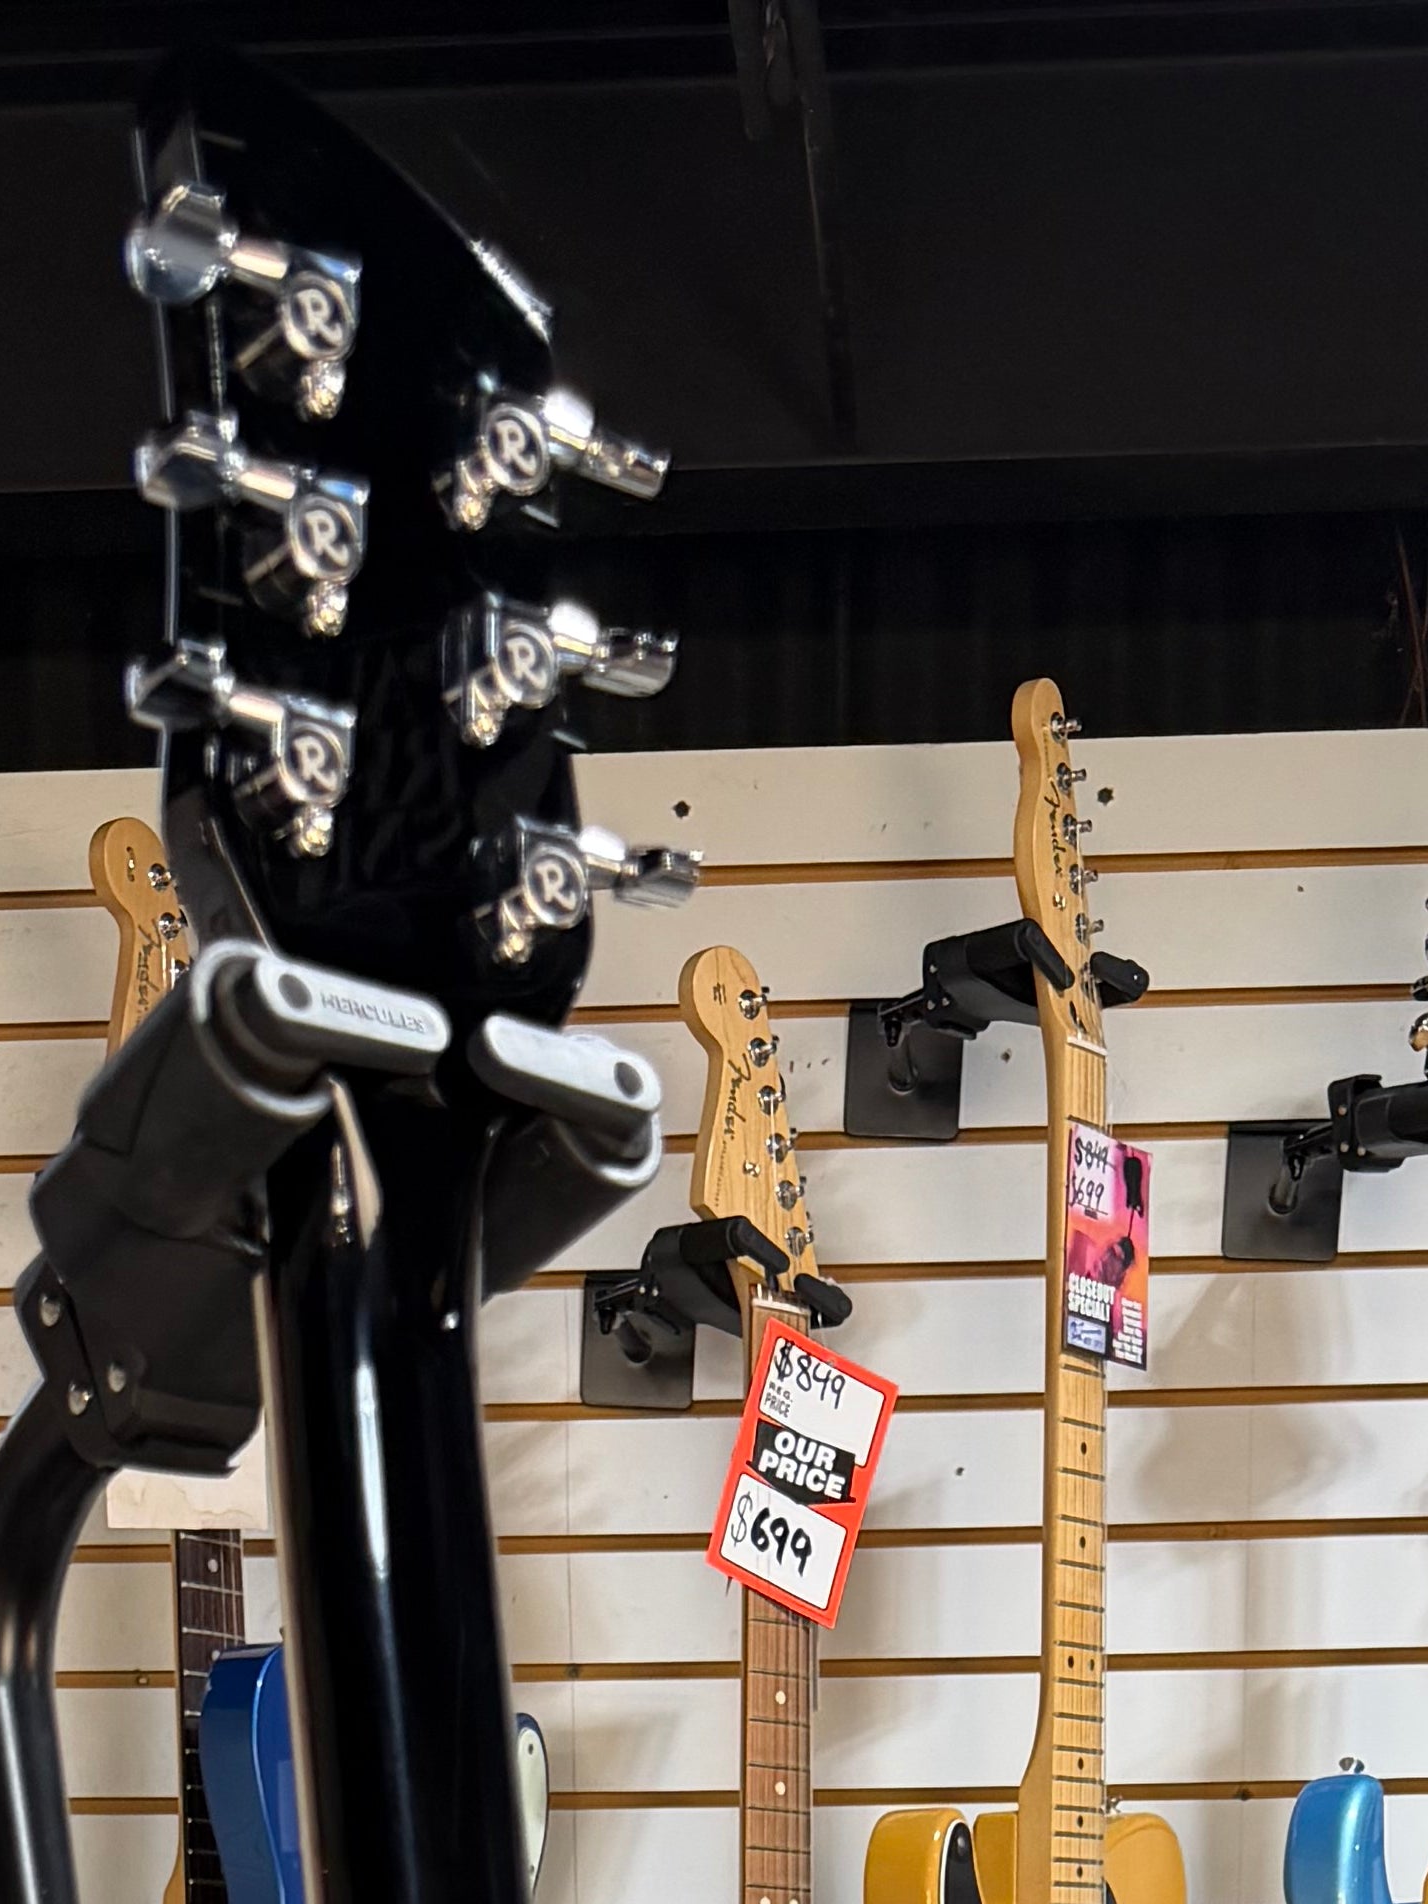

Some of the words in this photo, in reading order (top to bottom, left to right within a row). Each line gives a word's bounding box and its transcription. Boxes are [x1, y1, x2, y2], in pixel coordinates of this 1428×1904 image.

[320, 989, 427, 1037] HERCULES
[724, 1048, 751, 1141] Fender
[775, 1340, 847, 1410] $849
[763, 1392, 792, 1419] PRICE
[757, 1449, 847, 1500] PRICE
[774, 1430, 836, 1471] OUR
[730, 1491, 813, 1578] $699
